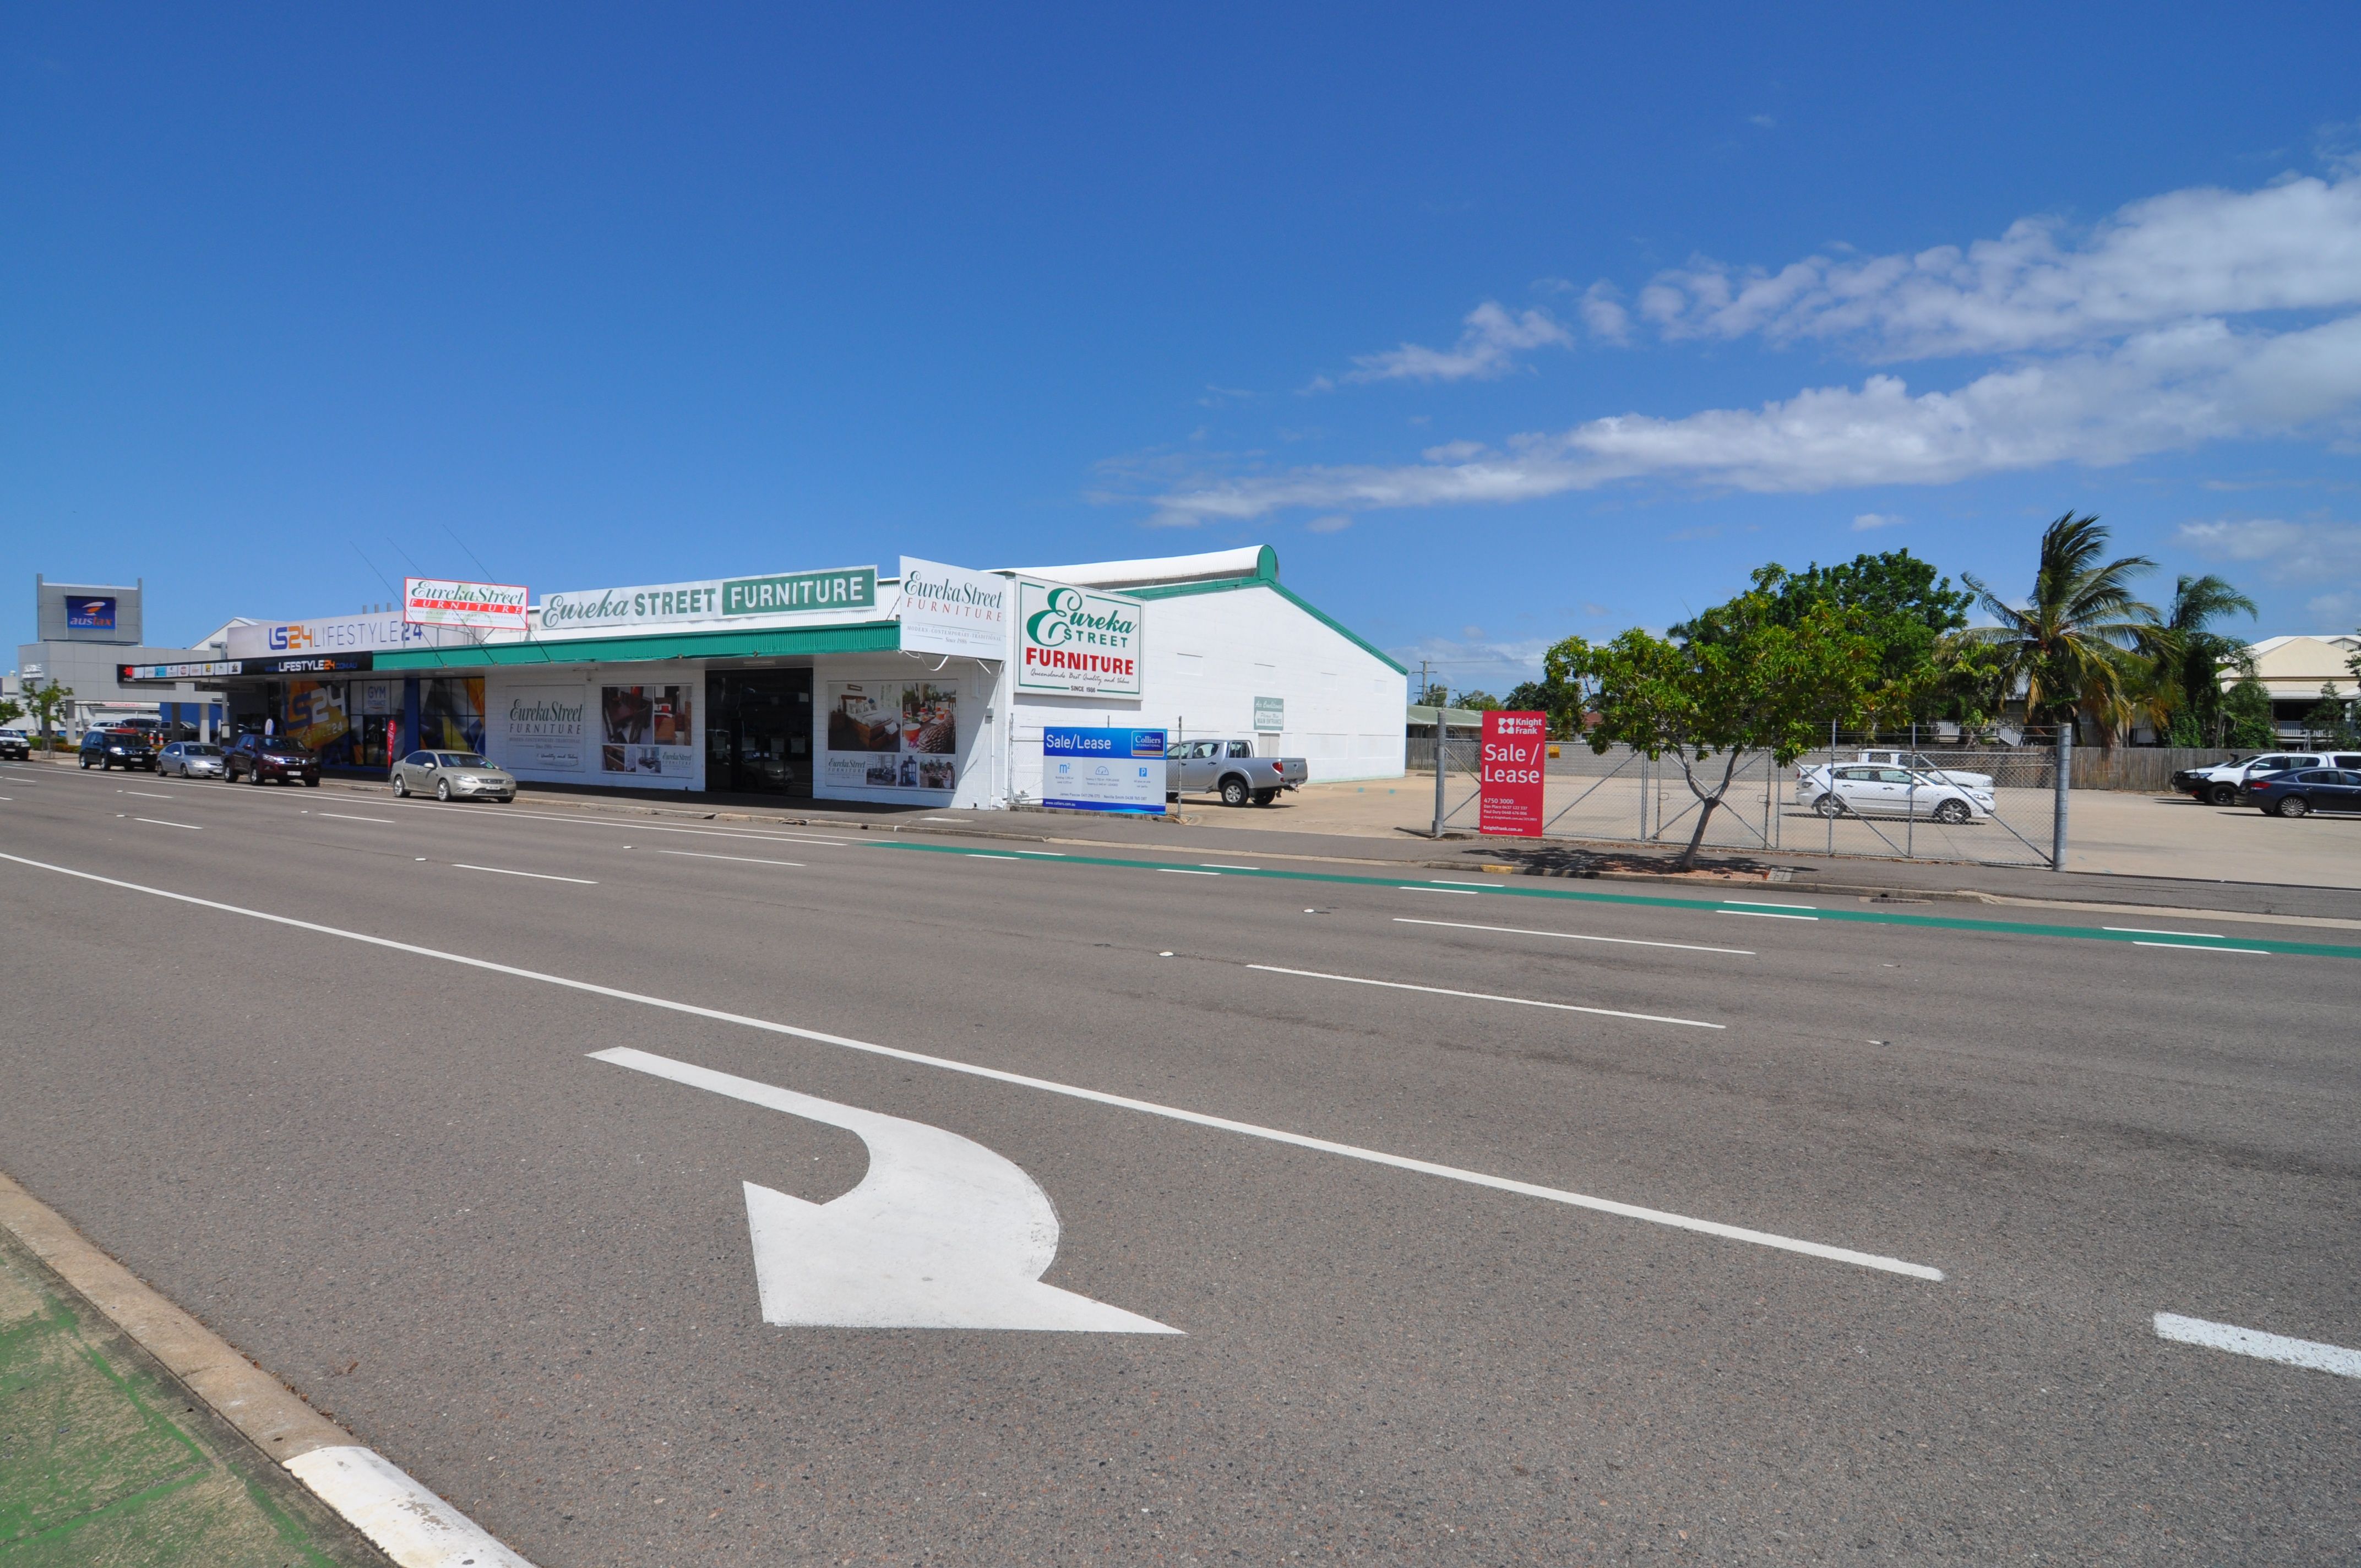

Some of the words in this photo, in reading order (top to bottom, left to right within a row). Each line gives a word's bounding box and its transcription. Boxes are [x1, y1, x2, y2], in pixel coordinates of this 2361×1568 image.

[731, 576, 863, 608] FURNITURE
[410, 600, 523, 614] FURNITURE
[542, 590, 630, 628] Eureka
[634, 588, 716, 616] STREET
[907, 597, 1002, 622] FURNITURE
[1026, 587, 1137, 647] Eureka
[931, 628, 969, 638] CONTEMPORARY
[972, 632, 1002, 641] TRADITIONAL
[1064, 628, 1128, 647] STREET
[1026, 647, 1134, 676] FURNITURE
[1031, 668, 1065, 678] Queenslands
[1083, 673, 1102, 685] Quality
[368, 686, 386, 699] GYM
[510, 723, 581, 734] FURNITURE
[1516, 718, 1542, 727] Knight
[1046, 734, 1111, 749] Sale/Lease
[1135, 736, 1161, 744] Colliers
[1484, 743, 1526, 762] Sale
[1484, 765, 1539, 784] Lease
